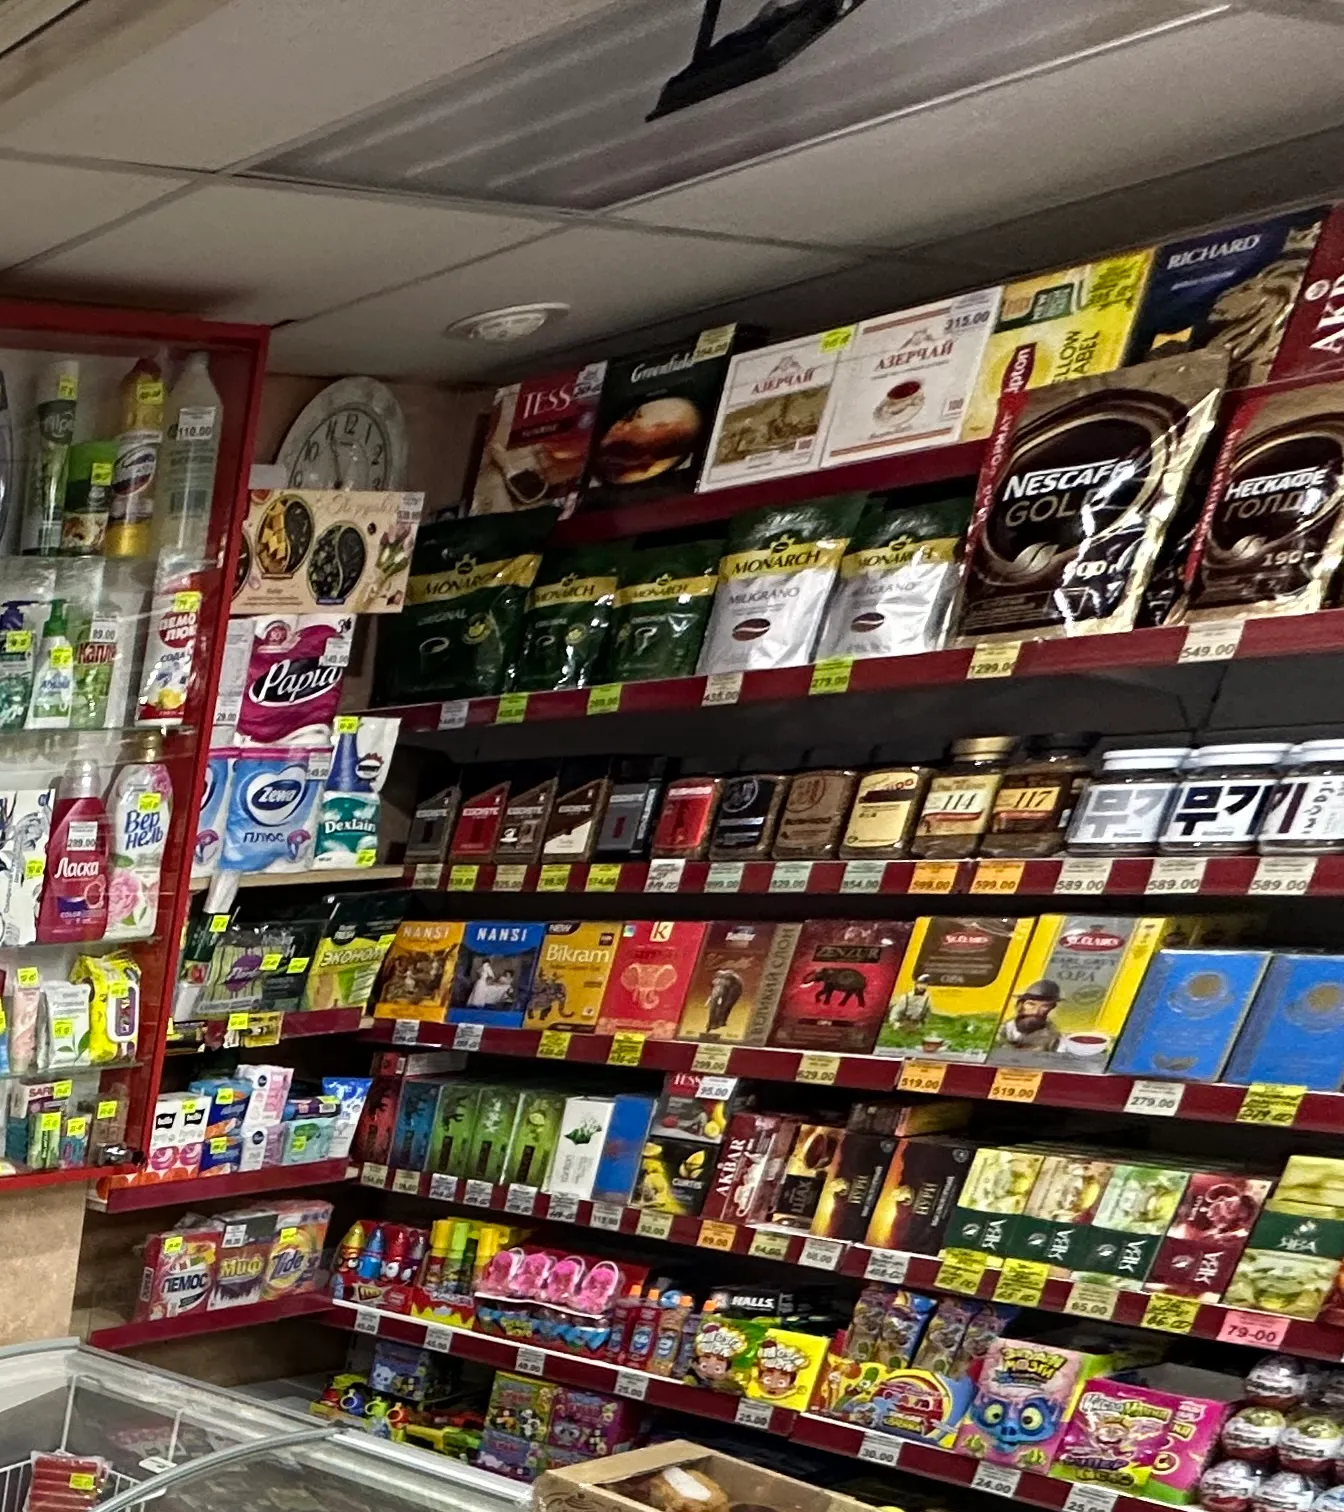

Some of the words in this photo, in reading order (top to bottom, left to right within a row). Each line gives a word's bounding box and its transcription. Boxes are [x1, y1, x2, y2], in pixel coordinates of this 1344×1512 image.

[1167, 234, 1261, 270] RICHARD
[874, 340, 955, 372] АЗЕРЧАЙ
[1051, 329, 1081, 384] ELLOW
[1076, 330, 1101, 376] ABEL
[750, 367, 813, 396] АЗЕРЧАЙ
[522, 383, 574, 422] TESS
[734, 549, 821, 575] MONARCH
[1181, 643, 1235, 658] 549.00
[256, 657, 337, 703] Papia
[258, 785, 297, 803] Zewa
[324, 812, 377, 835] Dexlain
[53, 857, 100, 879] Ласка
[1057, 879, 1104, 892] 589.00
[1147, 878, 1200, 892] 589.00
[1253, 878, 1307, 892] 589.00
[476, 927, 528, 942] NANSI
[546, 944, 610, 964] Bikram
[700, 1085, 729, 1097] 95.00
[715, 1138, 746, 1197] AKBAR
[732, 1295, 775, 1310] HALLS
[1226, 1325, 1277, 1343] 79-00
[975, 1475, 1012, 1494] 24.00
